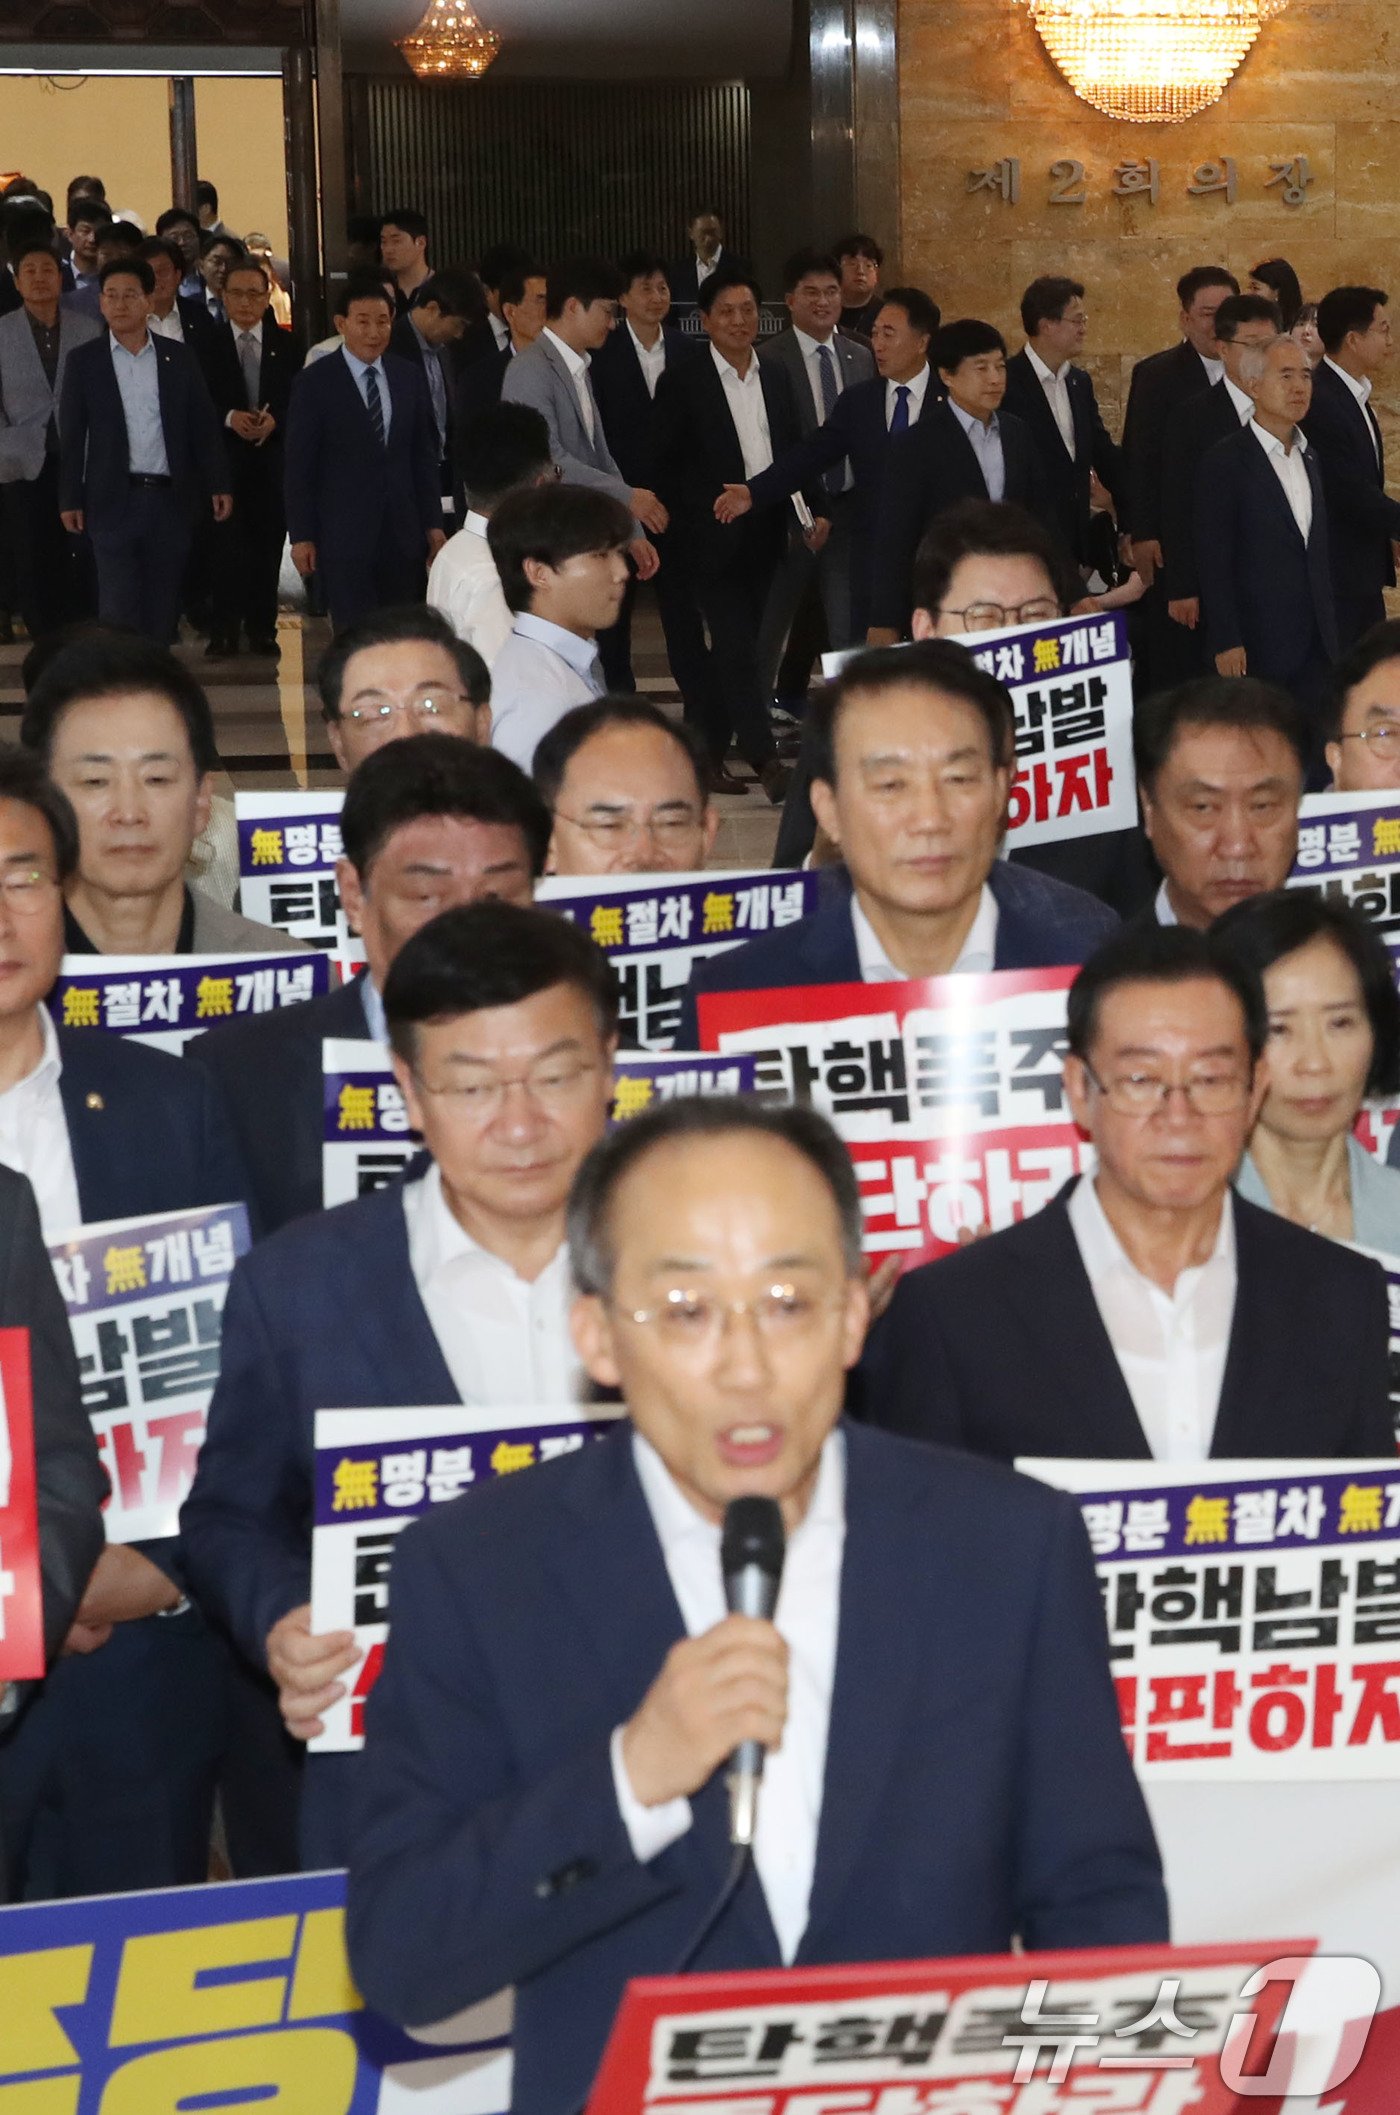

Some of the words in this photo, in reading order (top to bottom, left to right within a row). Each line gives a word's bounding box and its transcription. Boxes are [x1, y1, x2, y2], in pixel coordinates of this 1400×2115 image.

[967, 156, 1314, 211] 제2회의장
[1032, 621, 1117, 674] 無개념
[590, 892, 694, 948] 無절차
[702, 880, 806, 935] 無개념
[62, 977, 185, 1028] 無절차
[195, 964, 315, 1018] 無개념
[103, 1220, 236, 1295] 無개념
[1184, 1486, 1326, 1545] 無절차
